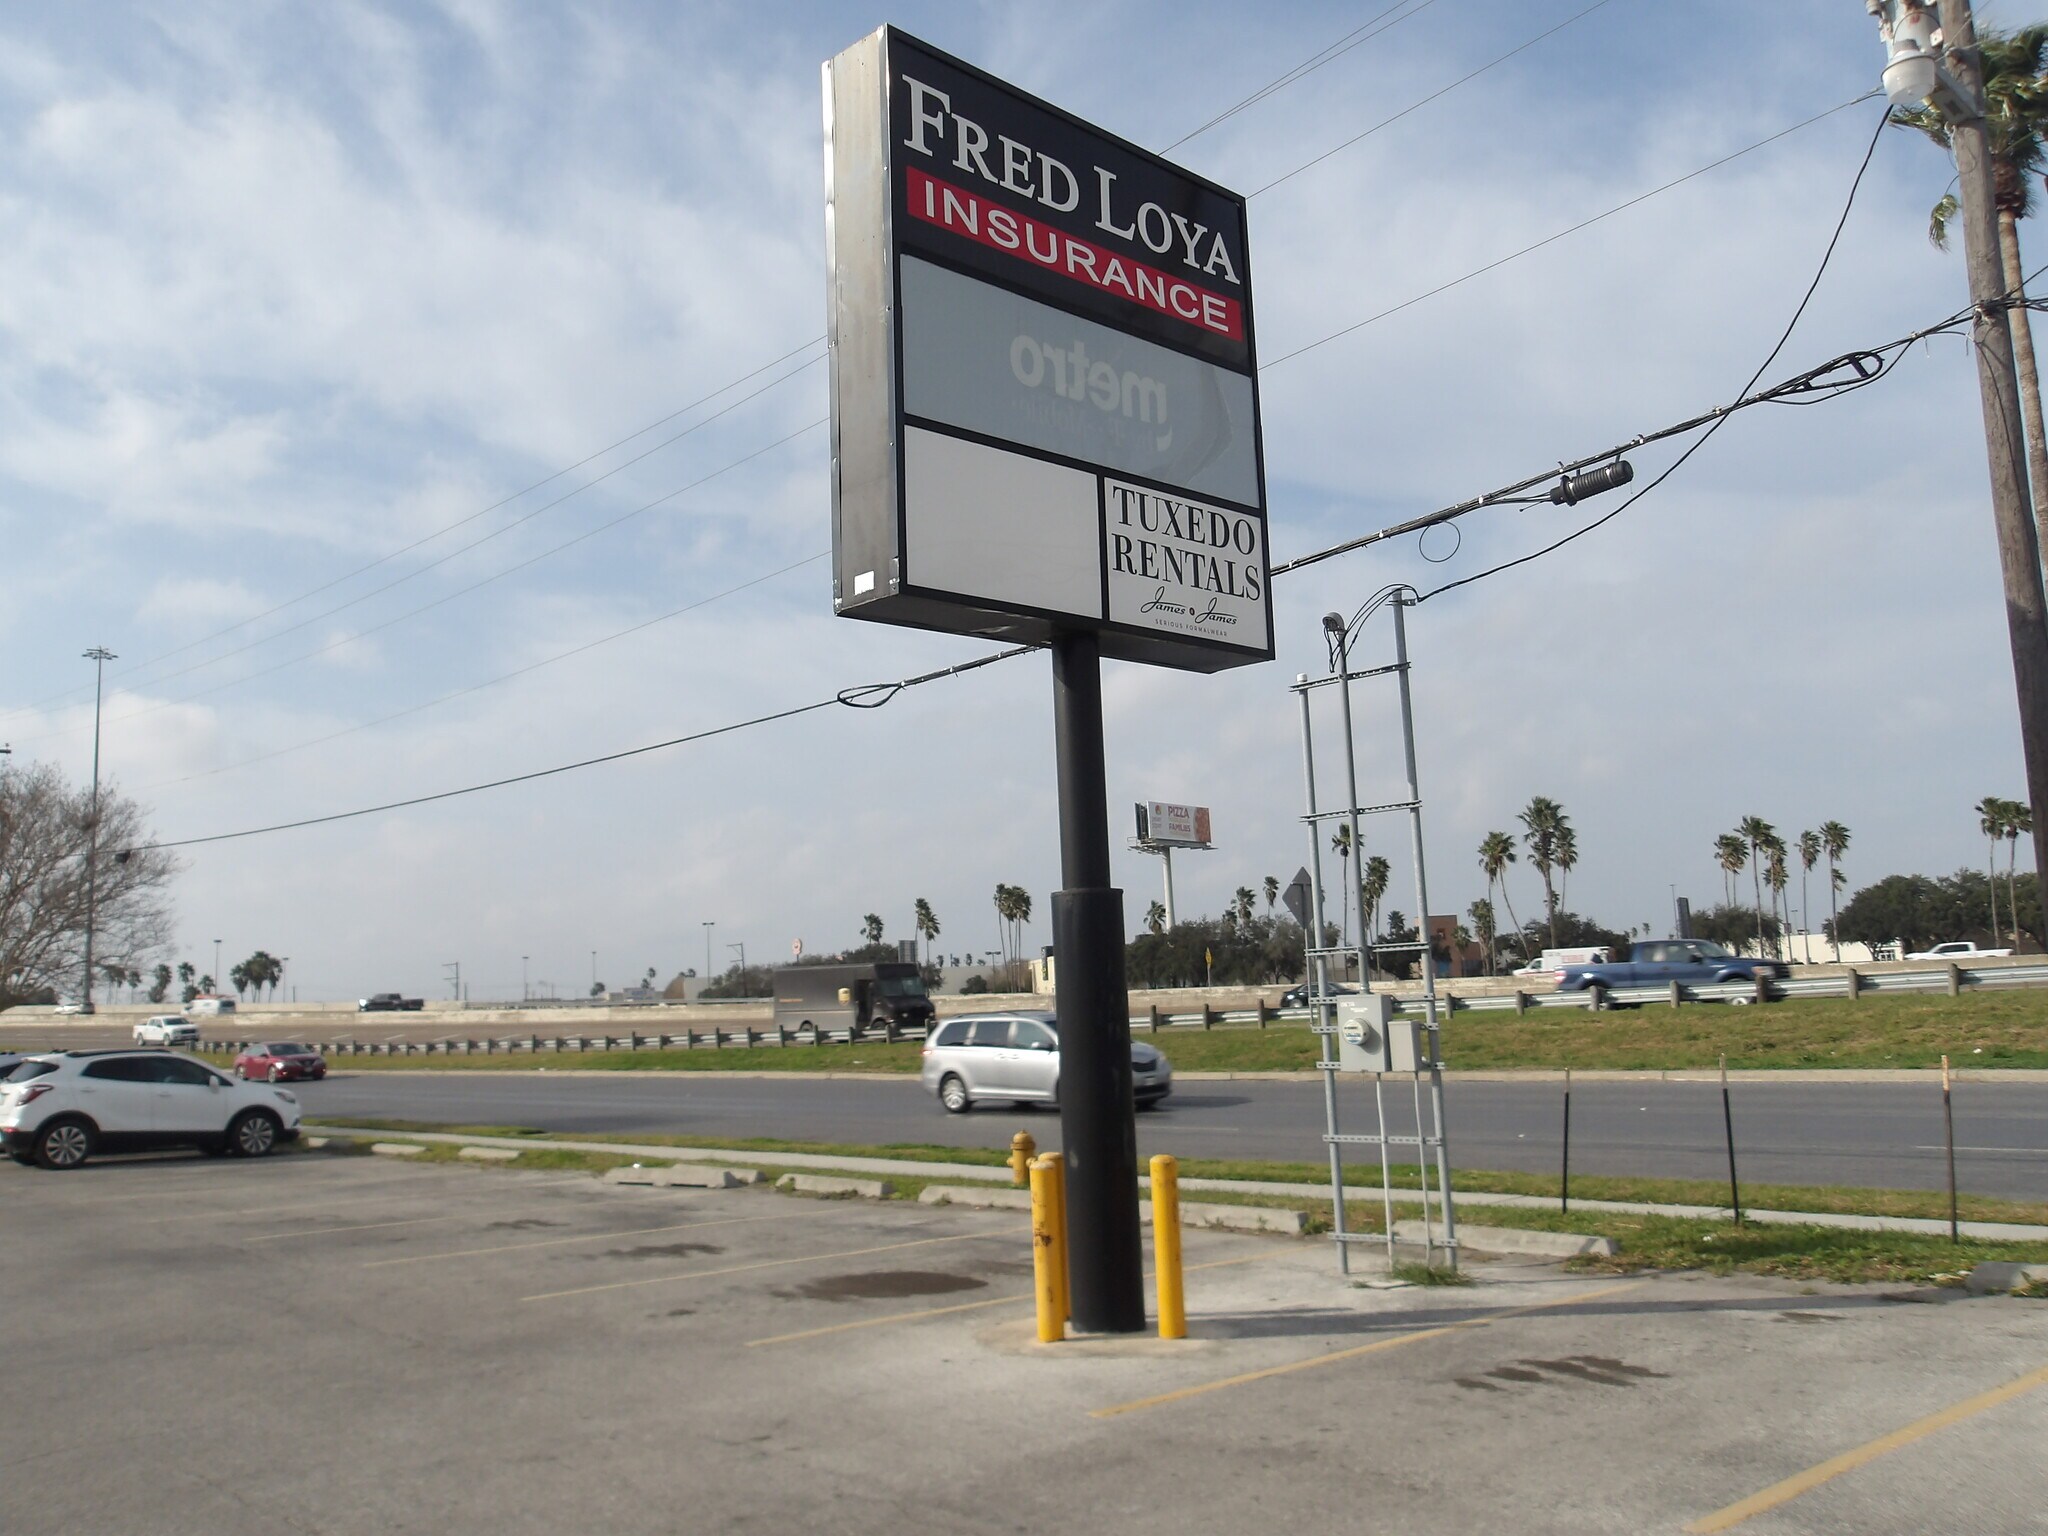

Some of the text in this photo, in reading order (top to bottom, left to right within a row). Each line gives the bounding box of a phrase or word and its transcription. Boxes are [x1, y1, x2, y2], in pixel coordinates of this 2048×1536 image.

[902, 74, 1241, 284] FRED LOYA
[925, 180, 1229, 332] INSURANCE
[1112, 485, 1255, 555] TUXEDO
[1111, 533, 1261, 601] RENTALS
[1140, 585, 1238, 625] James James
[1155, 618, 1228, 637] SERIOUS FORMALWEAR
[1167, 805, 1189, 818] PIZZA
